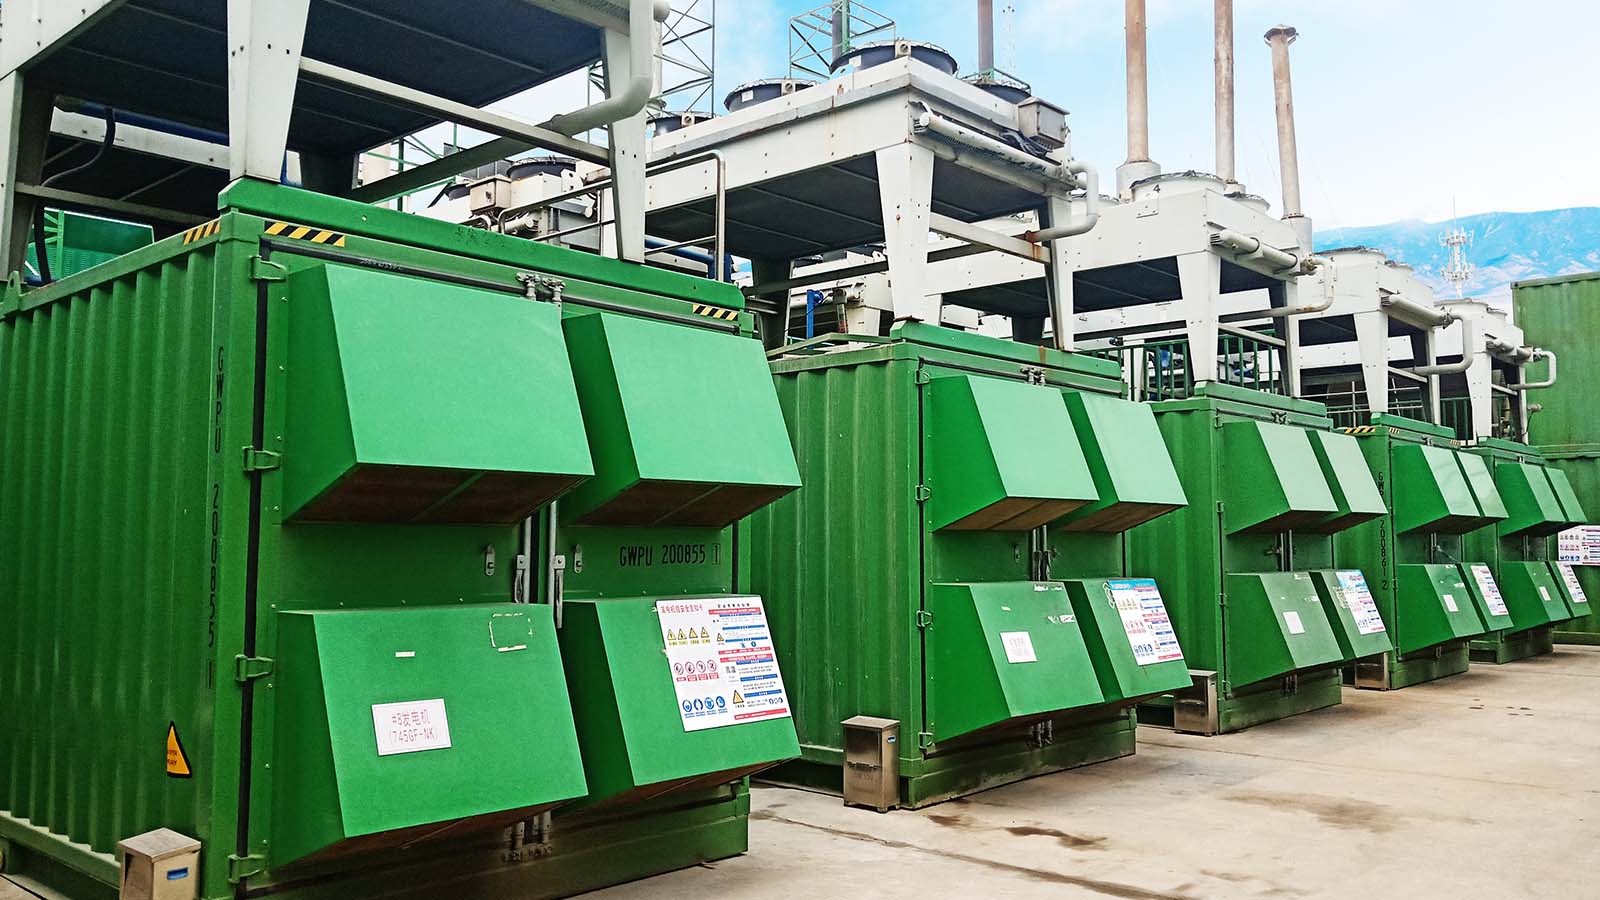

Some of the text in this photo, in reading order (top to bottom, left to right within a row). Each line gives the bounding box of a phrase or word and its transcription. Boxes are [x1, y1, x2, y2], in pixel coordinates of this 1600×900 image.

[1153, 184, 1161, 193] 4
[213, 346, 225, 455] GWPU
[207, 485, 219, 648] 200855
[619, 545, 653, 567] GWPU
[662, 544, 706, 564] 200855
